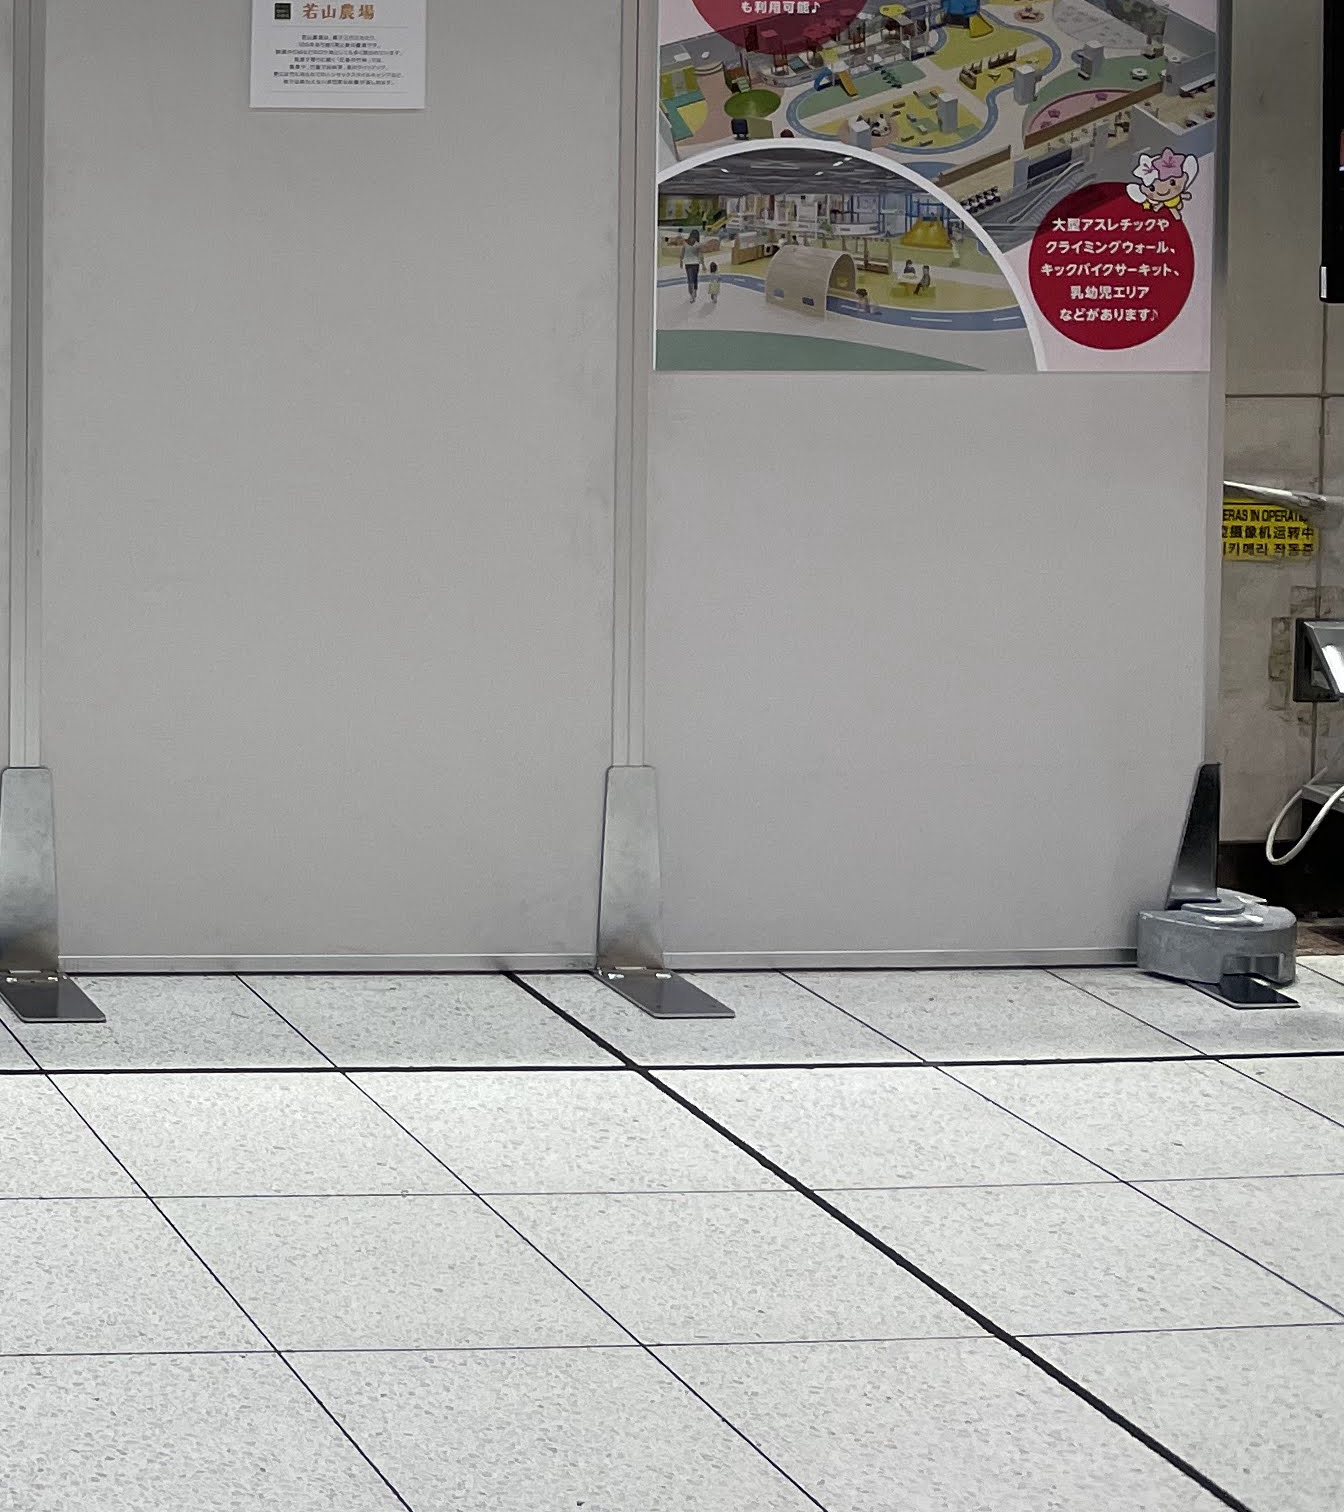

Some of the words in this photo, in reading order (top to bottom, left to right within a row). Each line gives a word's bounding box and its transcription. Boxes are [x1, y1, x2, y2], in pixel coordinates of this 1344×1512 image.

[302, 2, 376, 21] 若山農場
[1045, 240, 1176, 255] クライミングウォール、
[1040, 263, 1180, 277] キックバイクサーキット、
[1070, 285, 1150, 300] 乳幼児エリア
[1250, 509, 1260, 522] IN
